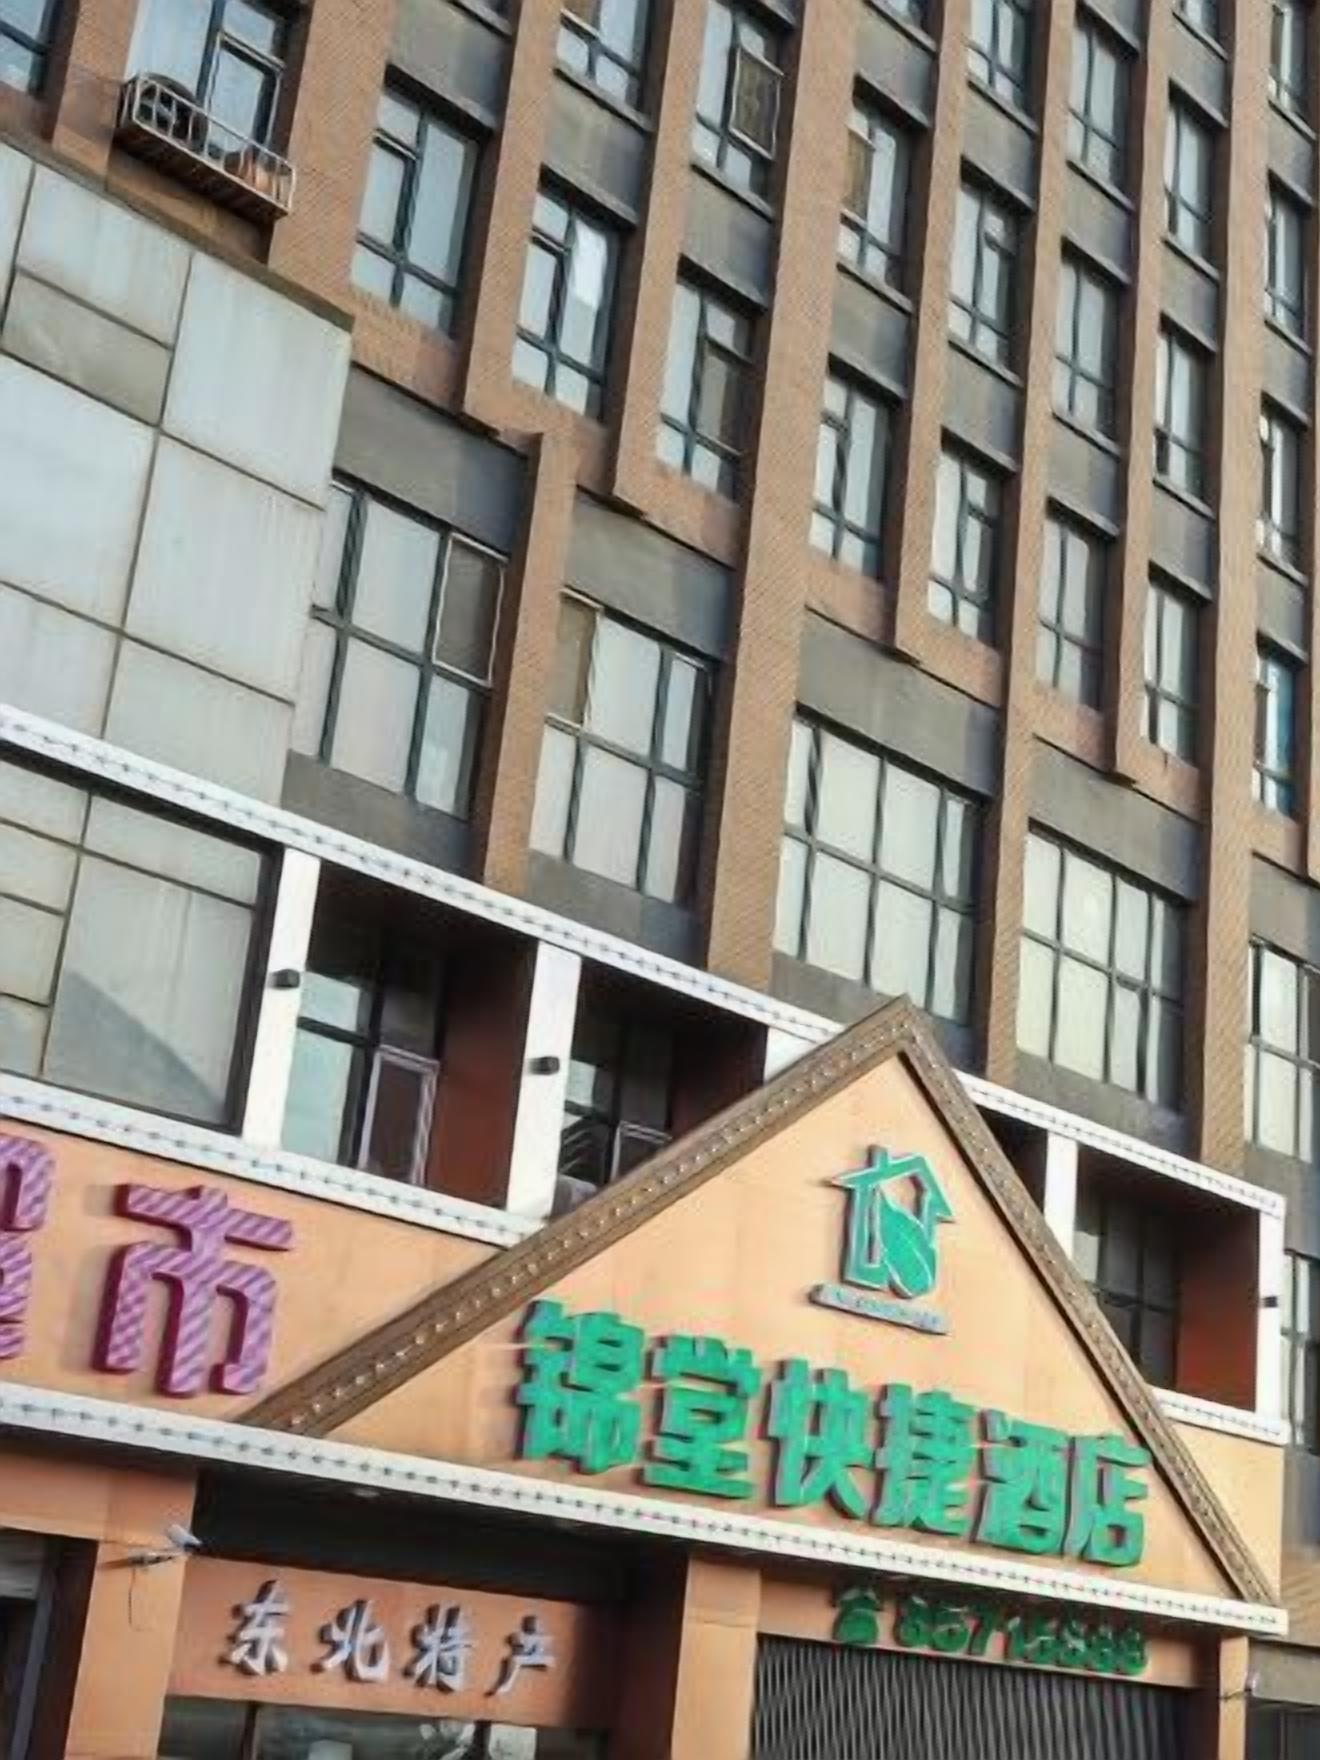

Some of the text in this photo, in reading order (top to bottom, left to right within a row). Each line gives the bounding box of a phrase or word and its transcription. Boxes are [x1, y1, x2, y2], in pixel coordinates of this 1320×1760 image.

[0, 1133, 292, 1398] 市
[517, 1300, 1153, 1567] 锦堂快捷酒店
[220, 1579, 555, 1696] 东北特产
